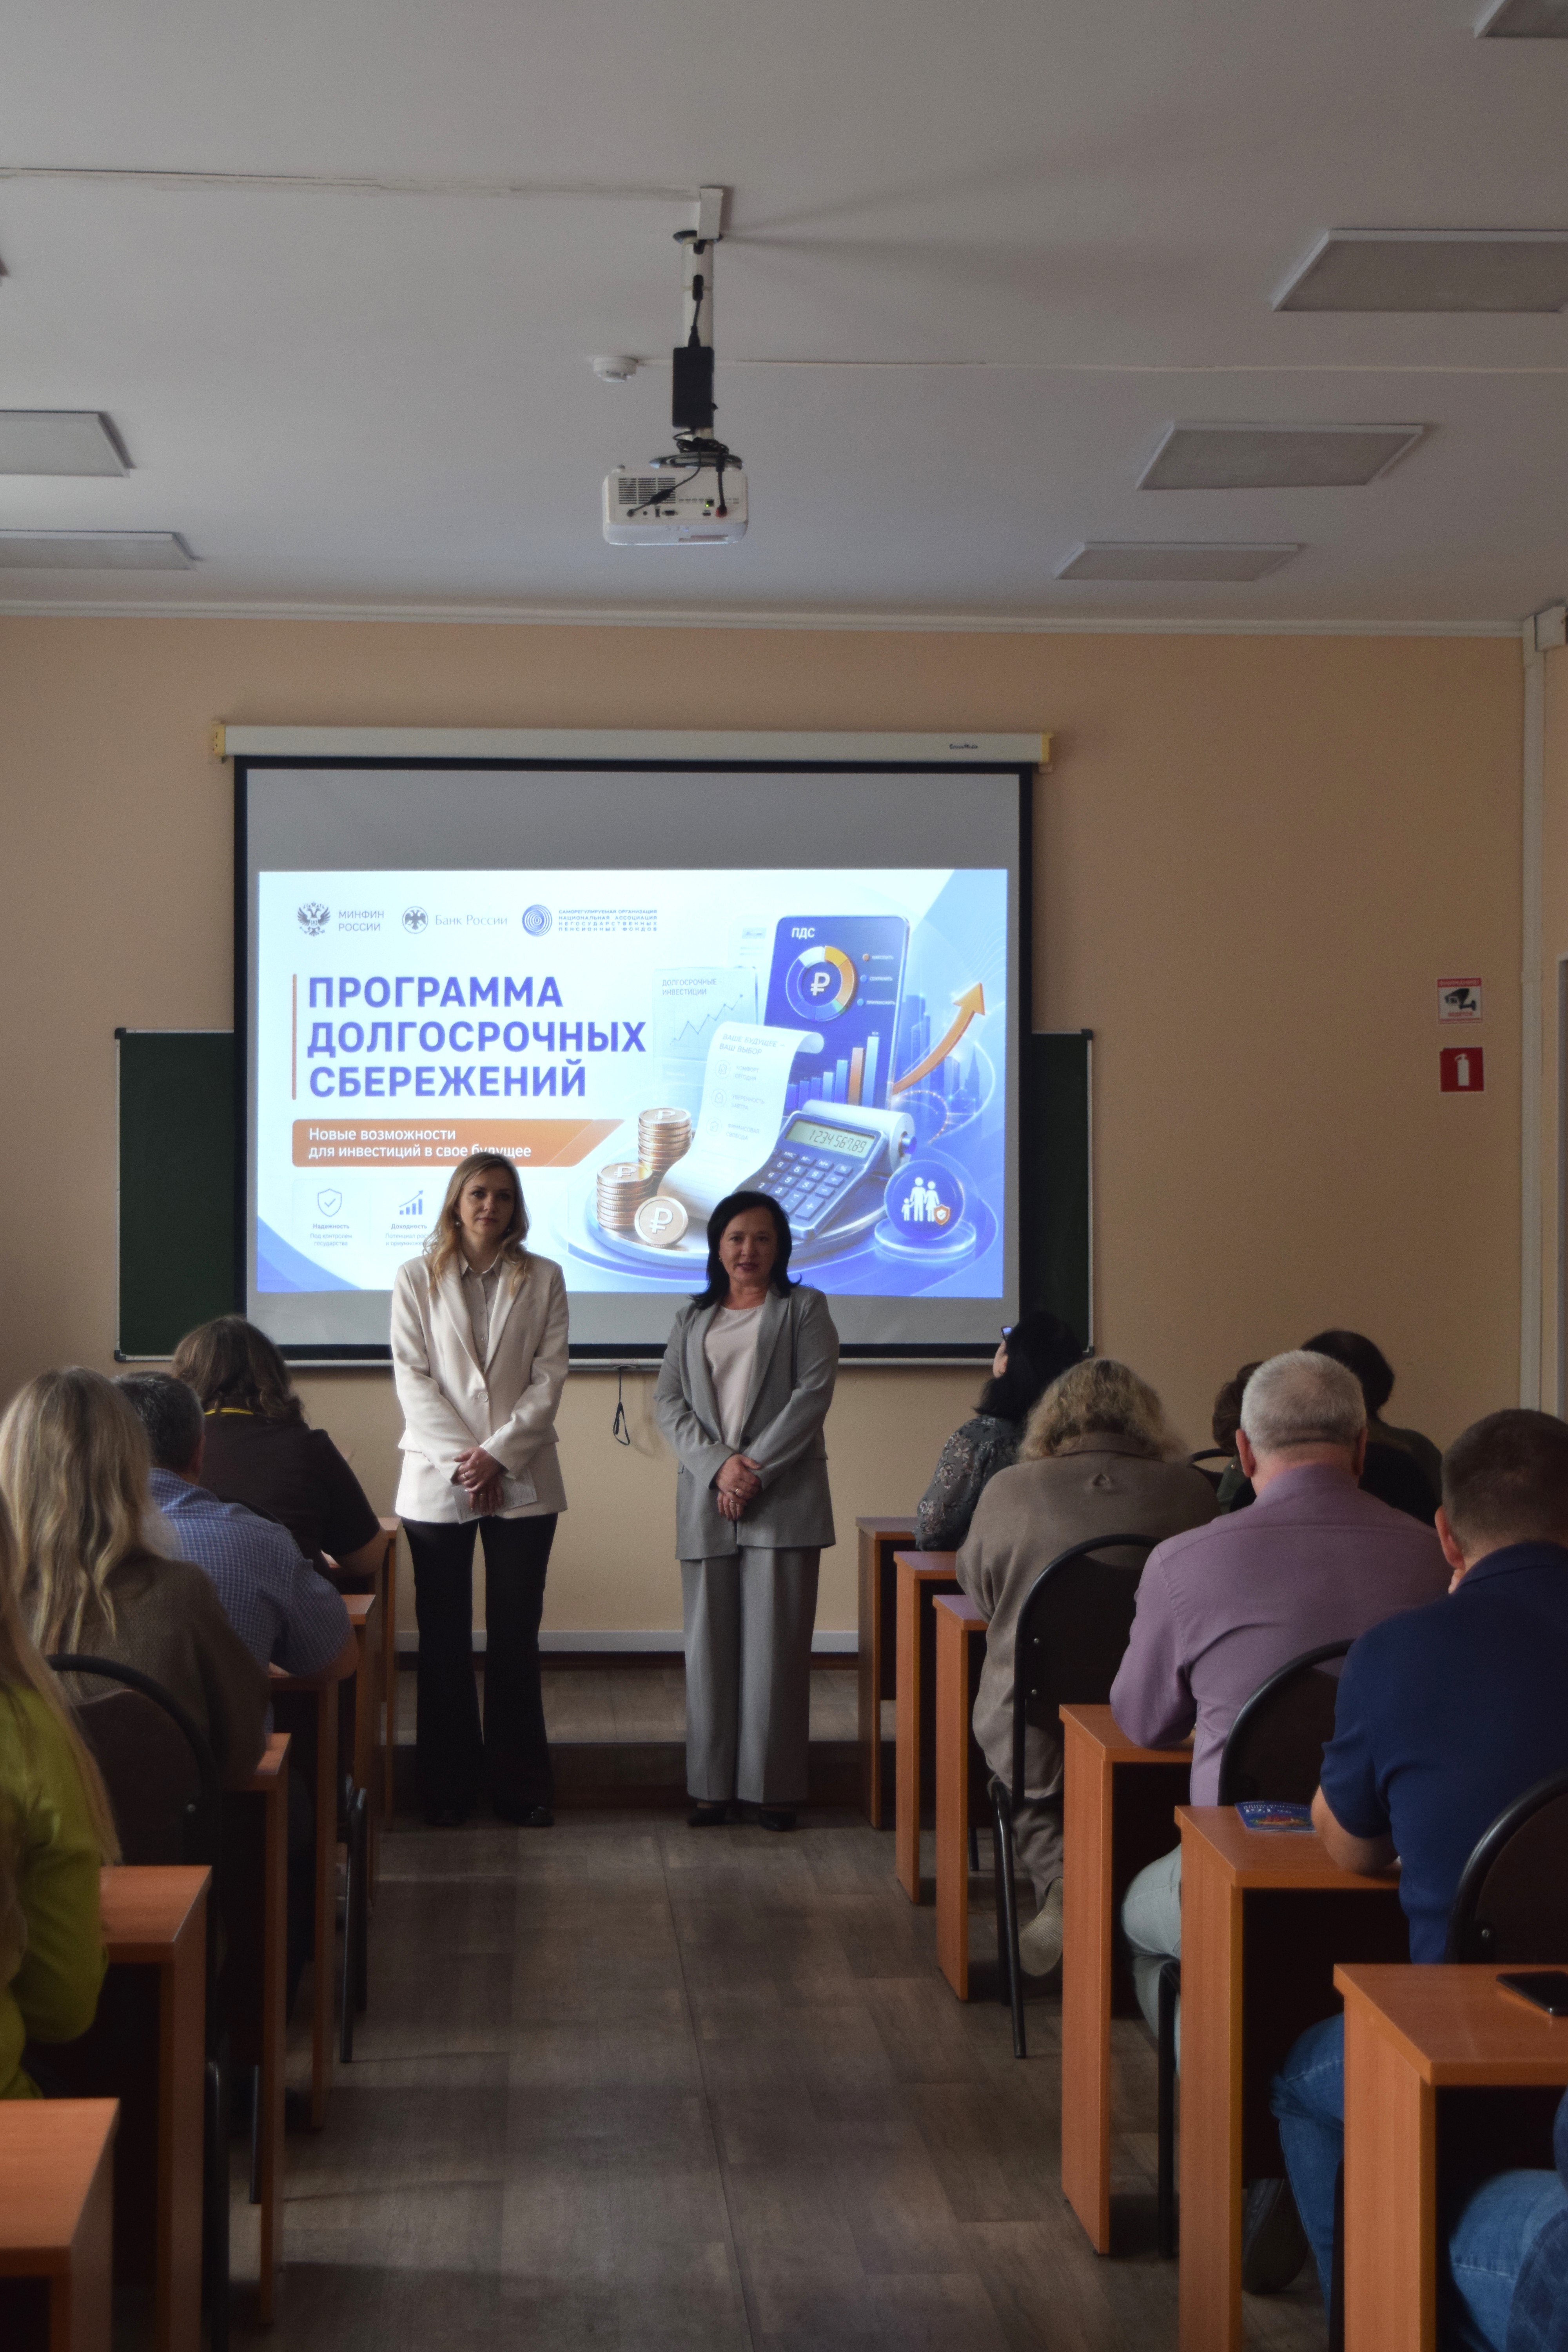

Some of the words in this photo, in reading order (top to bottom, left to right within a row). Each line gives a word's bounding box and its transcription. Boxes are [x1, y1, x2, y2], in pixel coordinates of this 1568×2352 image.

[338, 910, 384, 919] МИНФИН
[435, 915, 462, 925] Банк
[466, 915, 508, 925] России
[338, 923, 381, 931] РОССИИ
[791, 927, 815, 939] ПДС
[662, 978, 717, 987] ДОЛГОСРОЧНЫЕ
[309, 976, 563, 1008] ПРОГРАММА
[307, 1021, 646, 1058] ДОЛГОСРОЧНЫХ
[723, 1034, 743, 1042] ВАШЕ
[744, 1037, 778, 1047] БУДУЩЕЕ
[719, 1043, 735, 1051] ВАШ
[737, 1046, 762, 1054] ВЫБОР
[310, 1058, 586, 1097] СБЕРЕЖЕНИЙ
[310, 1128, 357, 1140] Новые
[361, 1130, 456, 1140] возможности
[309, 1147, 335, 1159] для
[339, 1143, 421, 1159] инвестиций
[425, 1147, 433, 1157] в
[436, 1147, 468, 1157] свое
